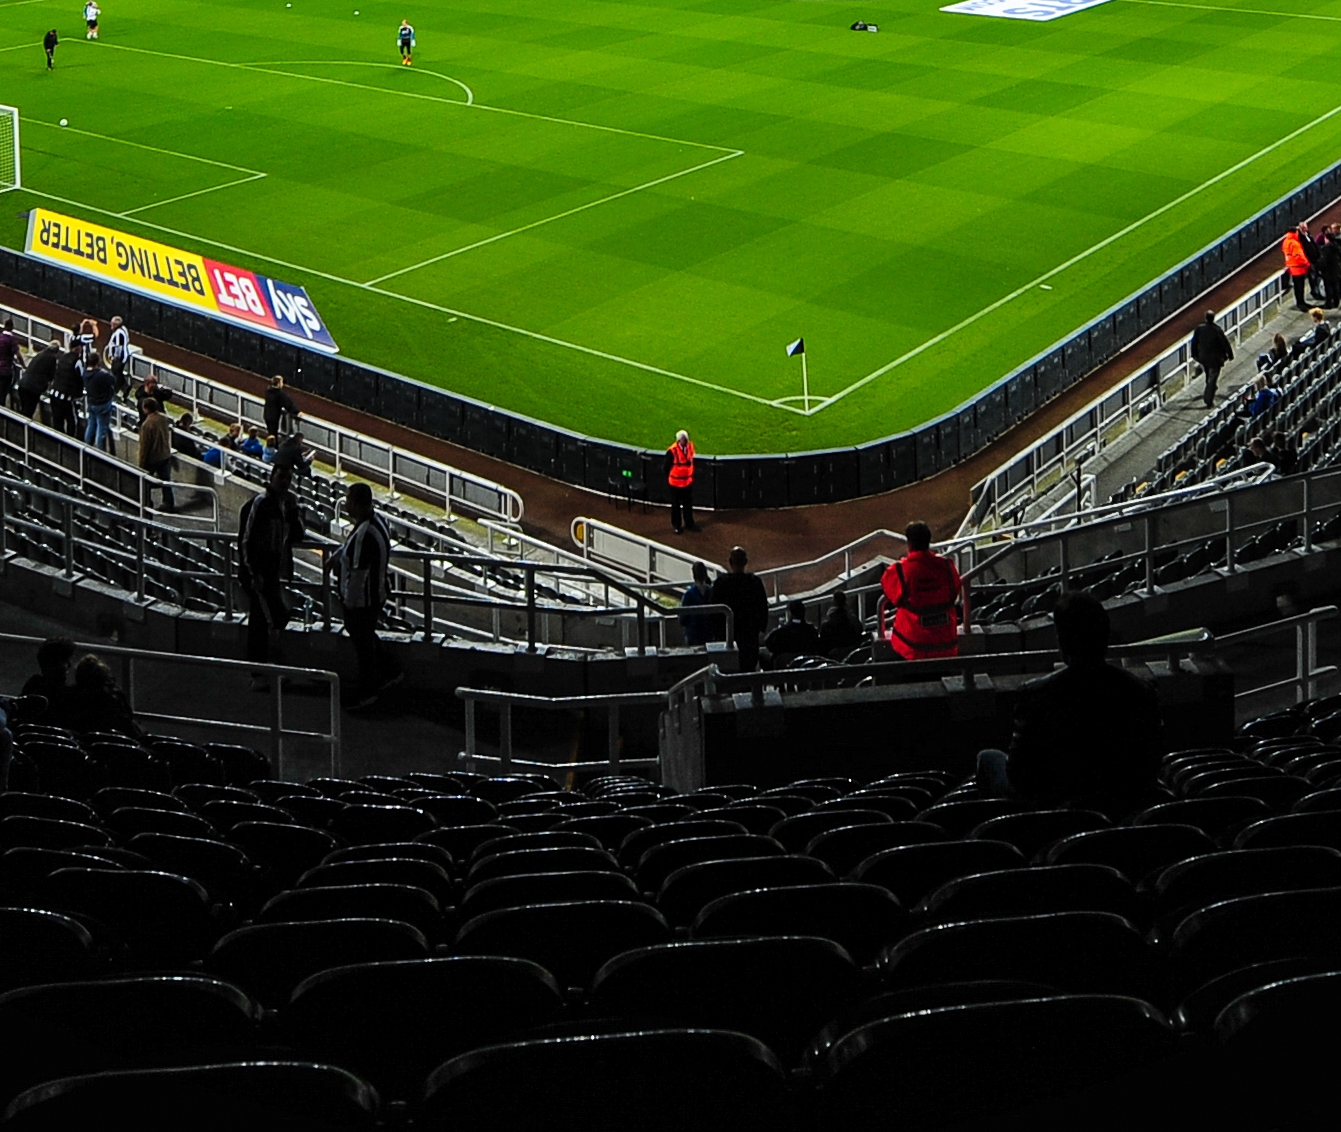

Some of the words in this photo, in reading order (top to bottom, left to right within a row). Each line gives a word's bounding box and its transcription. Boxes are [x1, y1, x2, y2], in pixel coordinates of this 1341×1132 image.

[40, 218, 108, 265] BETTER
[110, 235, 206, 297] BETTING,
[212, 267, 267, 317] BET
[267, 278, 322, 340] sky
